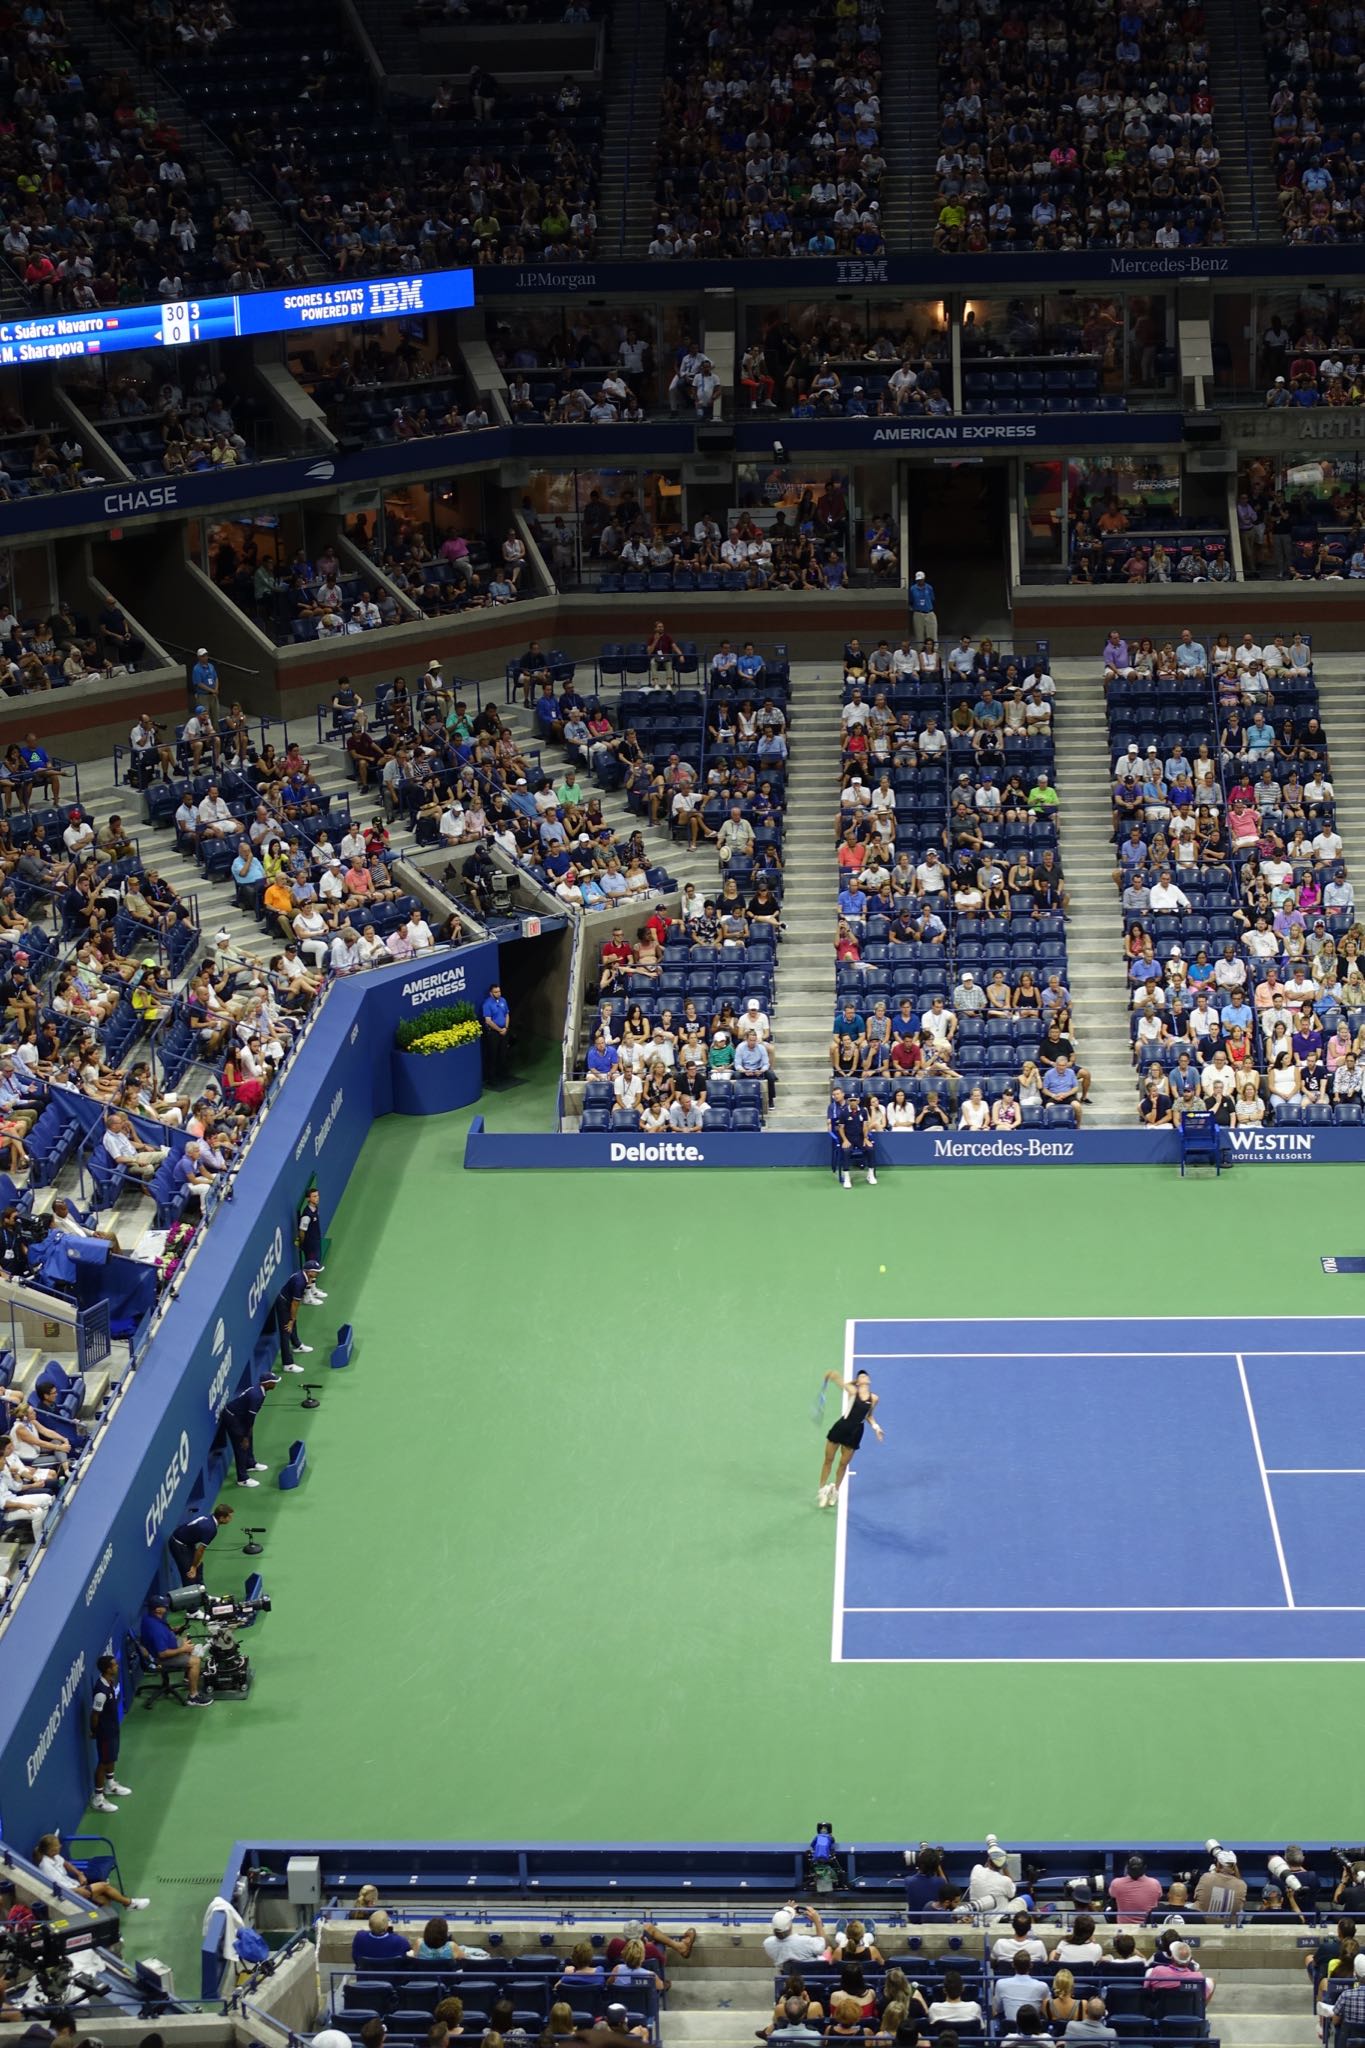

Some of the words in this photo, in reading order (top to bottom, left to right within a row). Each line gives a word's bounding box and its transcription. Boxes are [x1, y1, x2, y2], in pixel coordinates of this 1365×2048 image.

[836, 260, 889, 283] IBM
[1110, 257, 1229, 274] Mercedes-Benz
[516, 272, 596, 289] J.P.Morgan
[284, 293, 323, 309] SCORES
[325, 291, 333, 304] &
[334, 288, 364, 303] STATS
[368, 279, 424, 314] IBM
[167, 305, 184, 321] 30
[190, 303, 200, 320] 3
[301, 305, 349, 321] POWERED
[351, 302, 364, 315] BY
[1, 326, 13, 341] C.
[15, 322, 55, 340] Suárez
[58, 318, 104, 335] Navarro
[172, 326, 181, 341] 0
[192, 323, 200, 340] 1
[2, 347, 17, 362] M.
[20, 341, 84, 360] Sharapova
[873, 427, 957, 440] AMERICAN
[962, 425, 1036, 438] EXPRESS
[104, 485, 178, 514] CHASE
[402, 965, 465, 996] AMERICAN
[411, 978, 466, 1006] EXPRESS
[610, 1142, 705, 1161] Deloitte.
[934, 1138, 1075, 1158] Mercedes-Benz
[248, 1242, 276, 1319] CHASE
[146, 1451, 180, 1548] CHASE
[26, 1703, 61, 1787] Emirates
[61, 1650, 86, 1717] Airline
